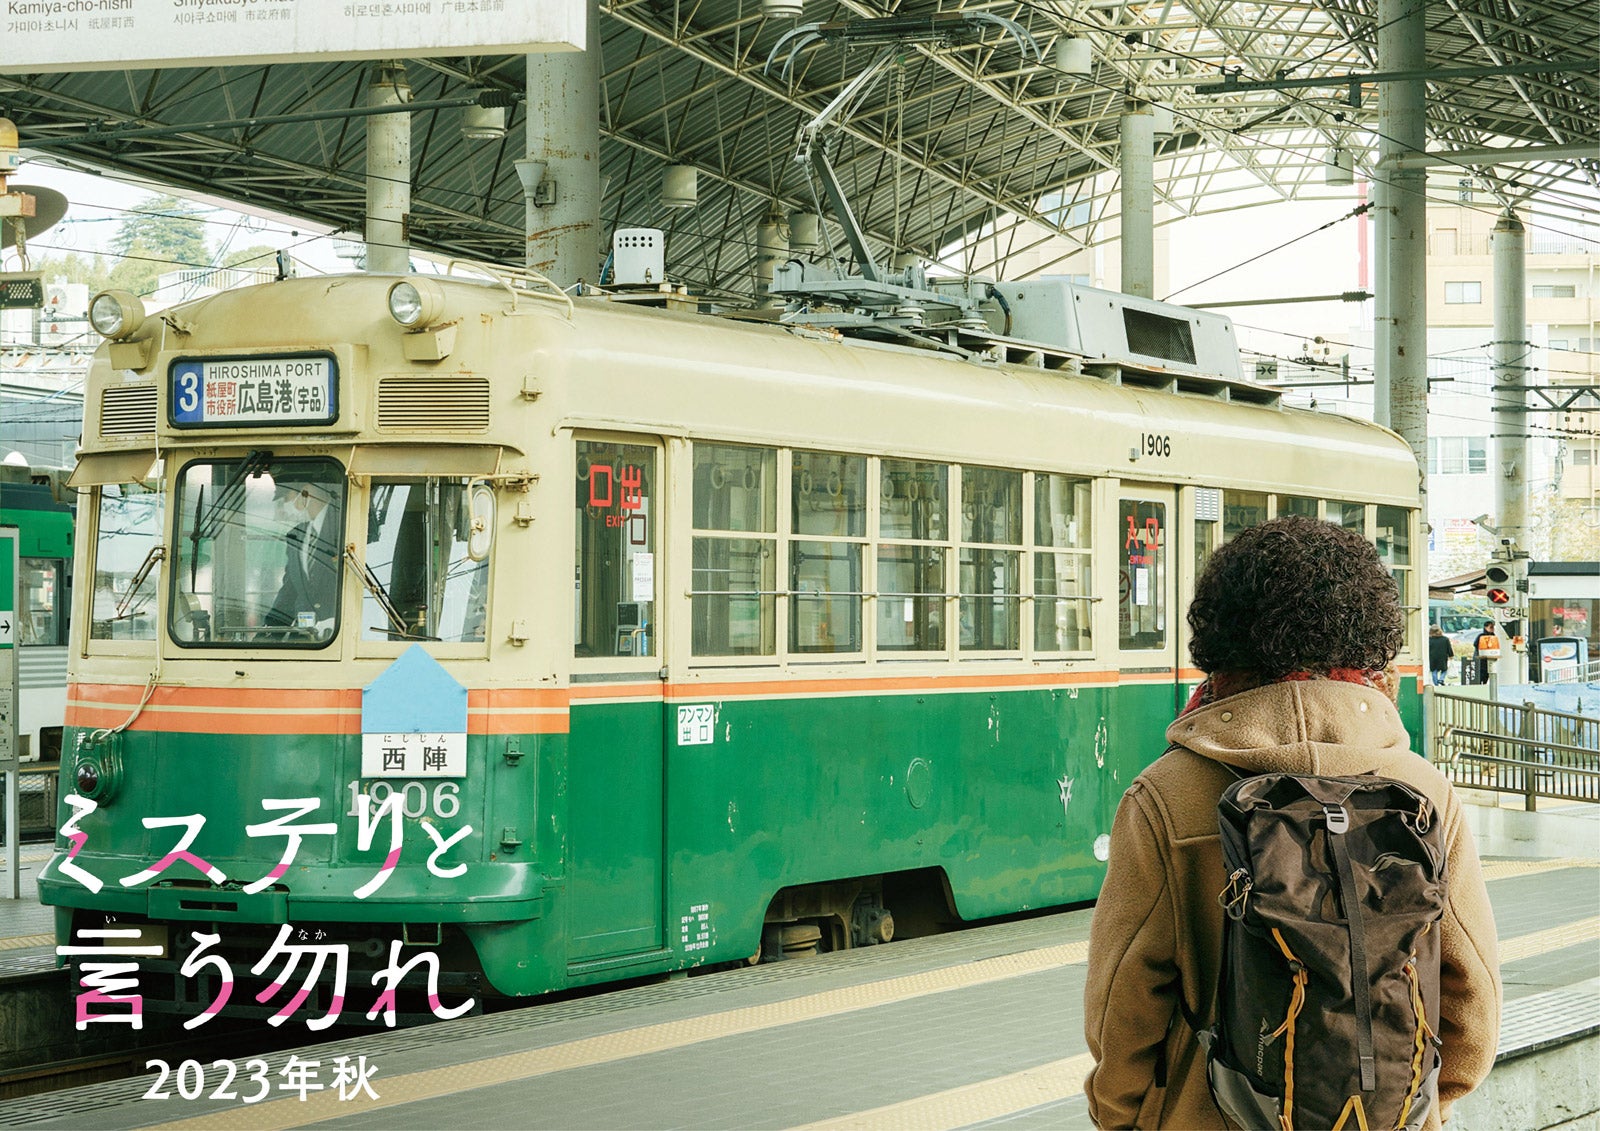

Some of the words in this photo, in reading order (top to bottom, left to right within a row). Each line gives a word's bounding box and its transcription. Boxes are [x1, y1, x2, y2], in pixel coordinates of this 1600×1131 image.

[8, 0, 133, 16] Kamiya-cho-nishi
[7, 18, 79, 33] 가미야초니시
[209, 364, 282, 380] HIROSHIMA
[285, 362, 322, 377] PORT
[179, 371, 199, 412] 3
[206, 381, 237, 399] 紙屋町
[206, 398, 237, 416] 市役所
[1141, 432, 1171, 457] 1906
[606, 515, 625, 527] EXIT
[1125, 516, 1159, 550] 入口
[679, 707, 713, 724] ワンマン
[383, 734, 447, 744] にしじん
[682, 725, 708, 742] 出口
[381, 745, 448, 772] 西陣
[346, 780, 461, 819] 1906
